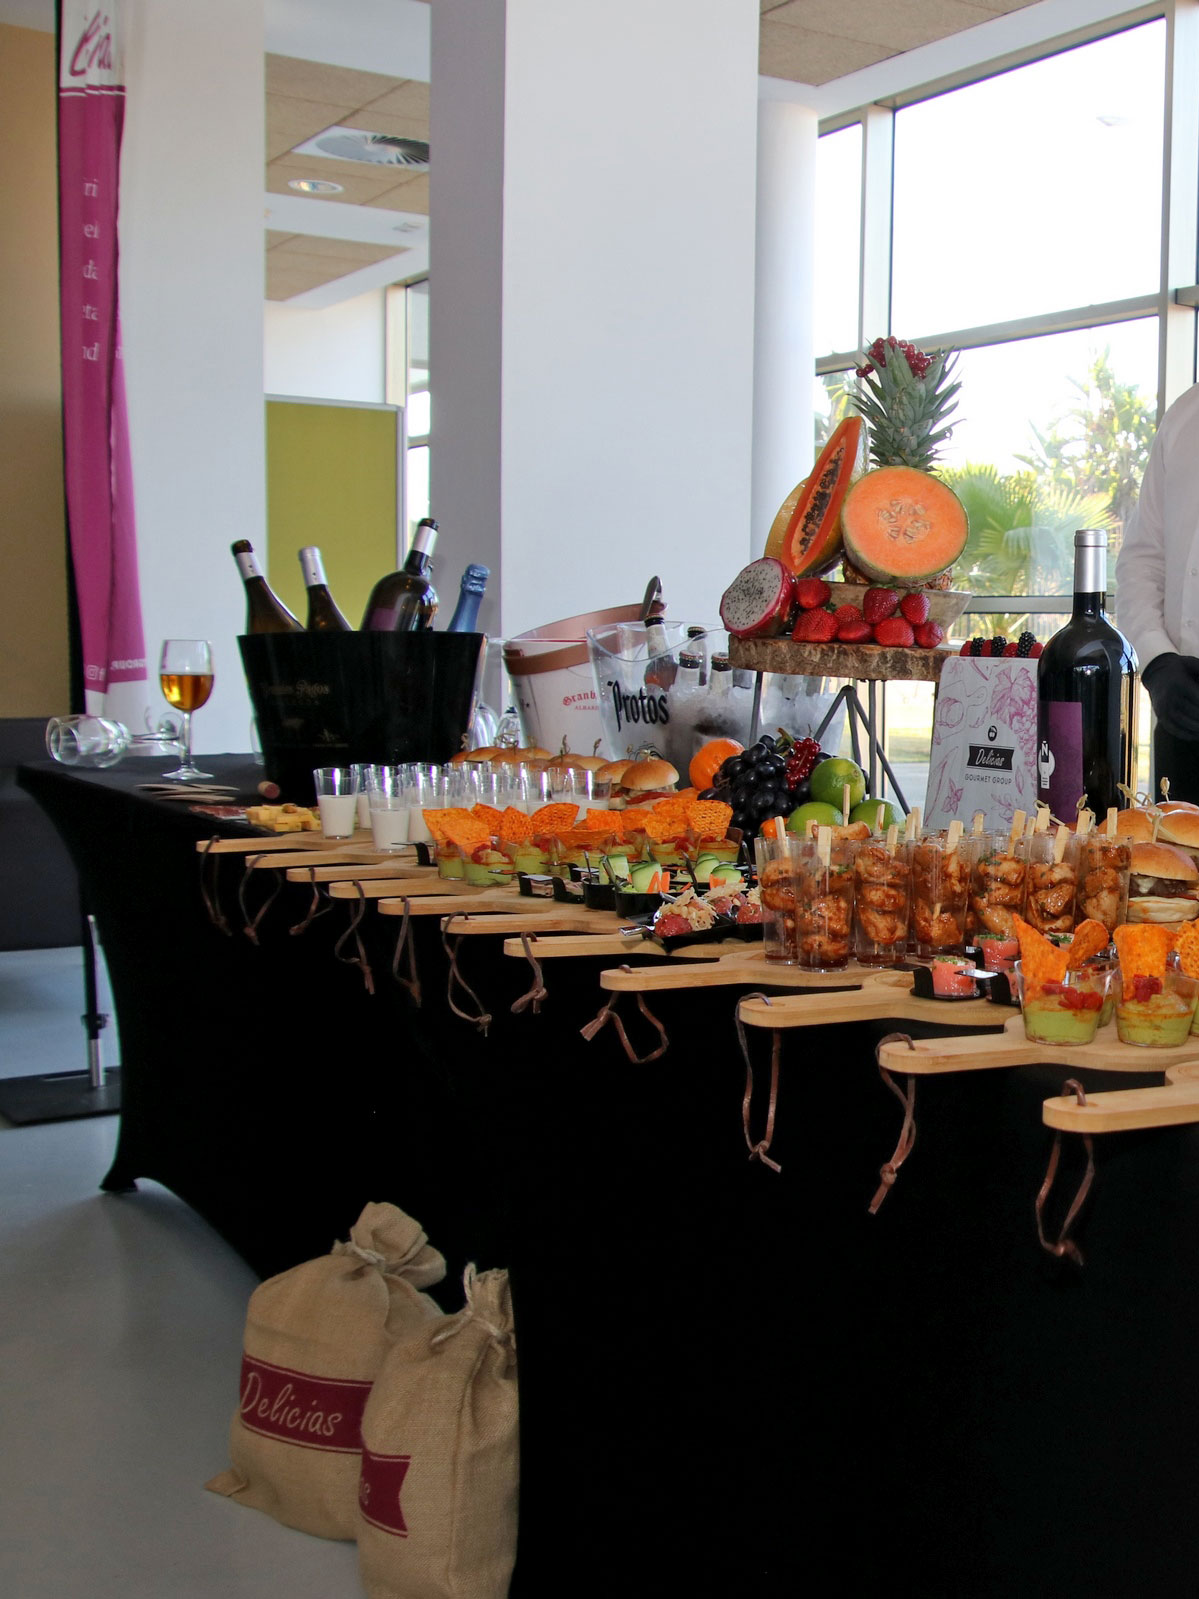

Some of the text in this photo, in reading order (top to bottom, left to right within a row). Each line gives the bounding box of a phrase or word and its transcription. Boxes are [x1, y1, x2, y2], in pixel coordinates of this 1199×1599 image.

[607, 680, 670, 733] Protos
[975, 748, 1005, 767] Delicias
[964, 773, 1013, 785] GOURMET GROUP
[241, 1371, 343, 1437] Delicias
